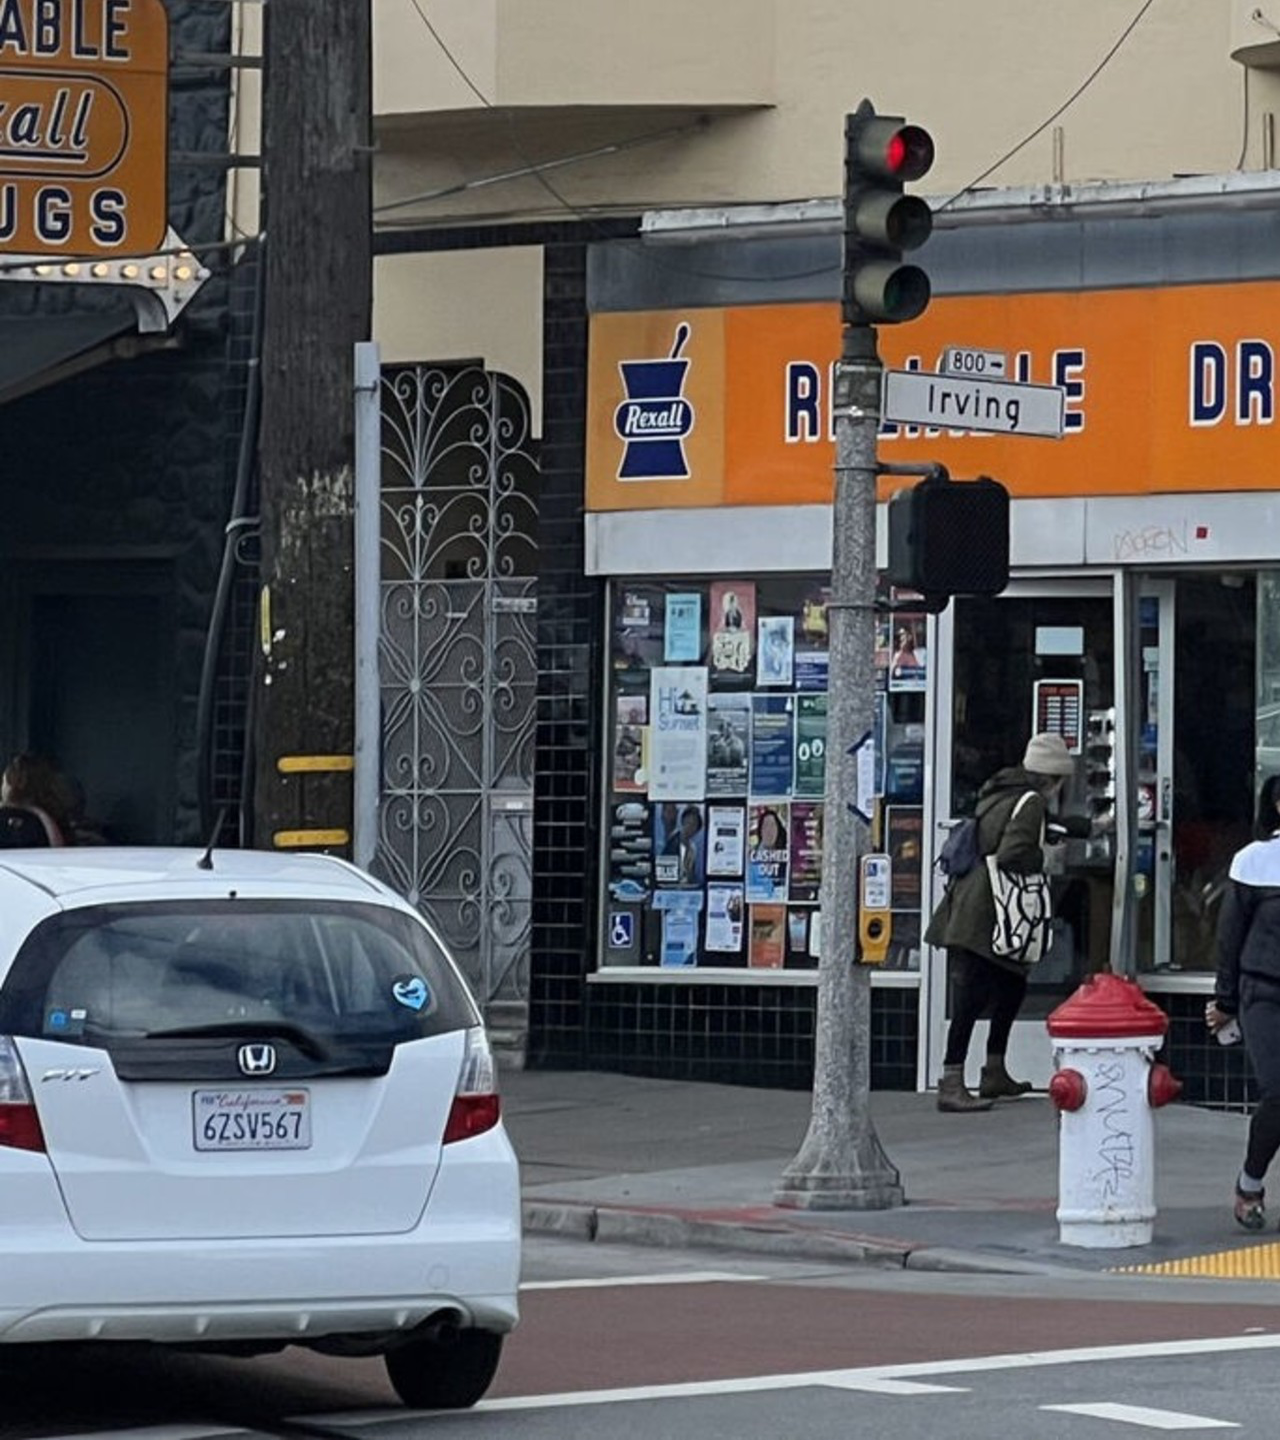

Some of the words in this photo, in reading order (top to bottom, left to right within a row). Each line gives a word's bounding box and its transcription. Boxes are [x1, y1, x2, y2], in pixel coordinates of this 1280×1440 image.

[953, 351, 985, 373] 800
[624, 403, 684, 435] Rexall
[928, 383, 1021, 429] Irving
[204, 1111, 302, 1142] 6ZSV567
